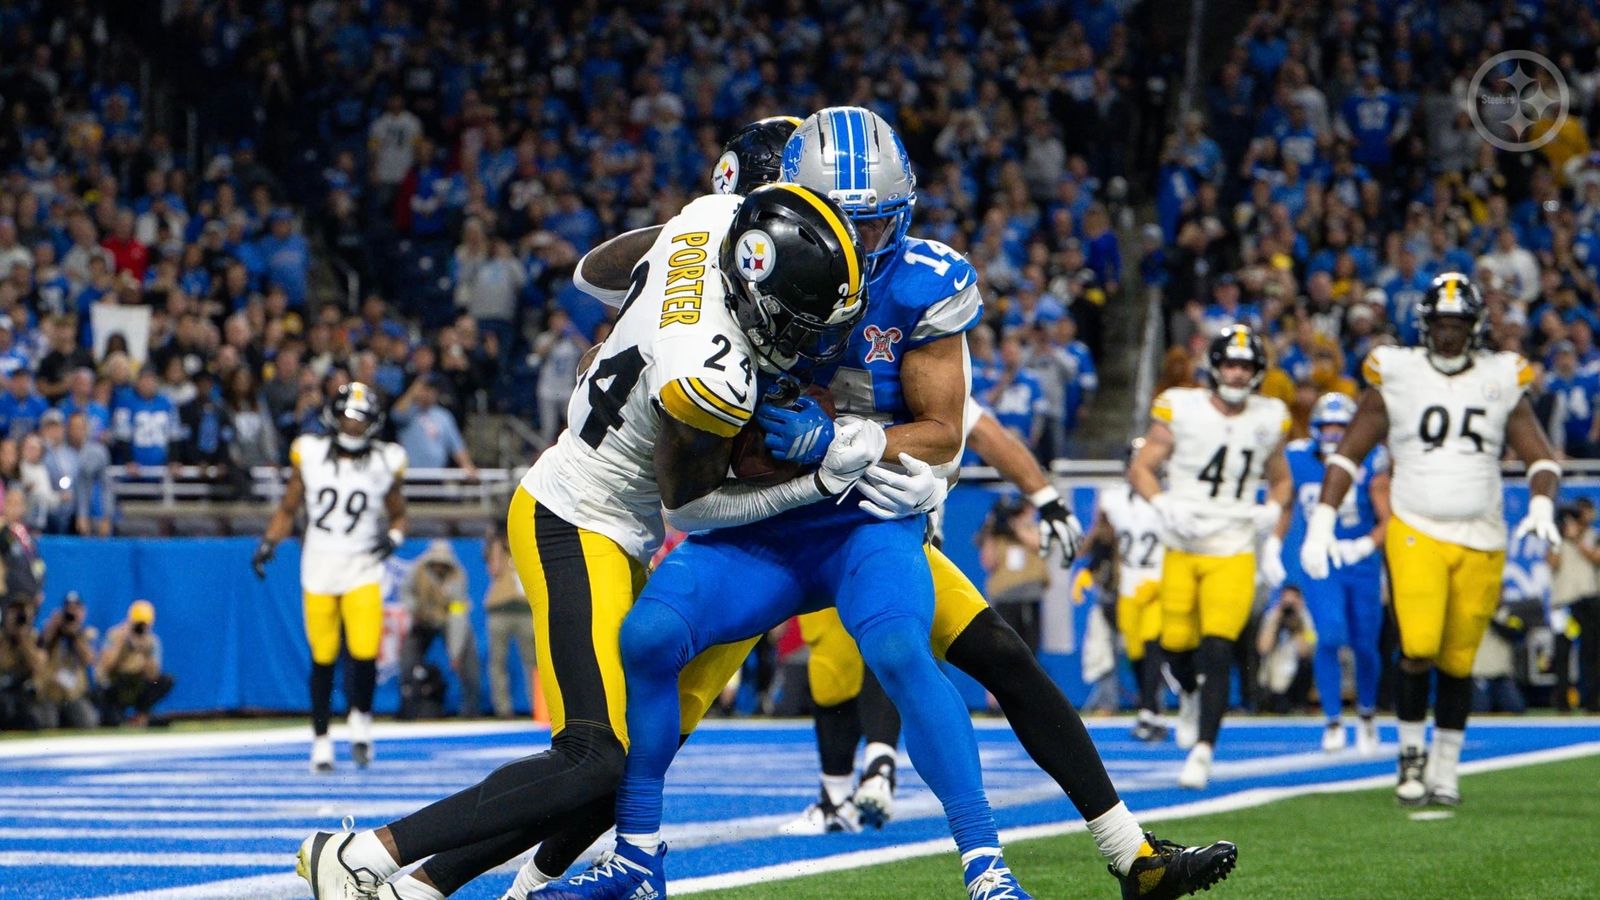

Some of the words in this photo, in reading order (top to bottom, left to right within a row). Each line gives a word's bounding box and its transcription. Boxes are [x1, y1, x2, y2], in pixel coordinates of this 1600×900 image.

[659, 231, 710, 329] PORTER
[903, 237, 968, 277] 14
[703, 334, 754, 386] 24
[1418, 405, 1487, 453] 95
[1197, 445, 1256, 499] 41
[315, 487, 368, 535] 29
[1116, 528, 1161, 568] 22
